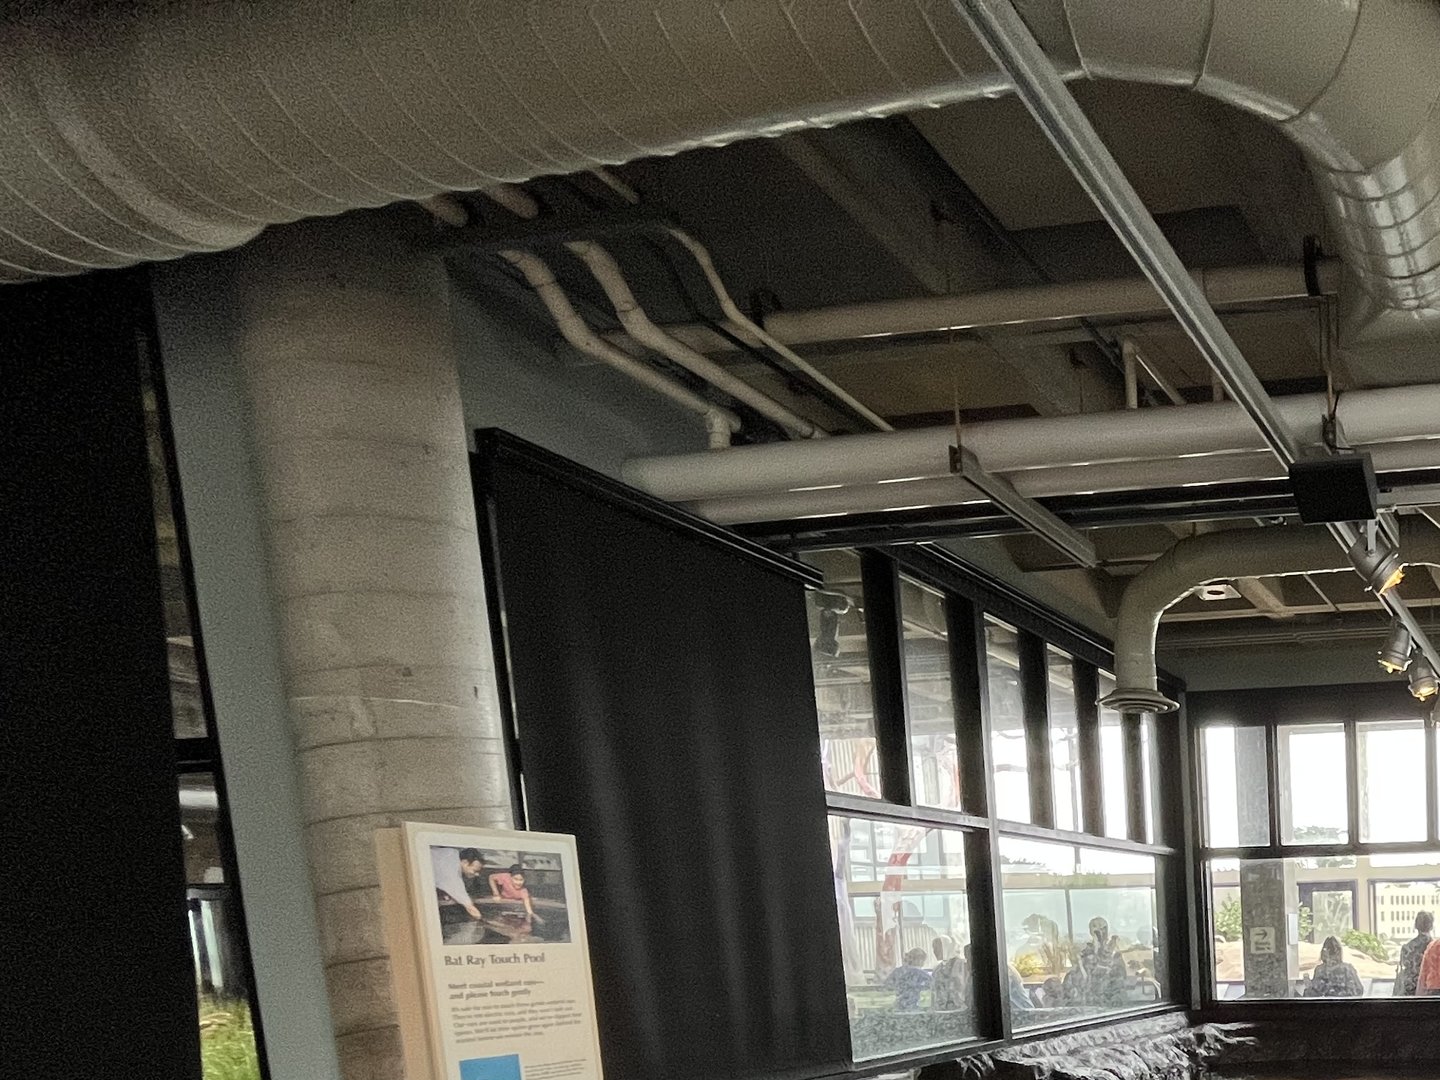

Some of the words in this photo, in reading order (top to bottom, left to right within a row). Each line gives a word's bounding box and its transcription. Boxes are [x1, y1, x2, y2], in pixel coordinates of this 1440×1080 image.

[444, 955, 464, 966] Bat
[466, 955, 486, 968] Ray
[488, 953, 520, 964] Touch
[523, 952, 545, 963] Pool
